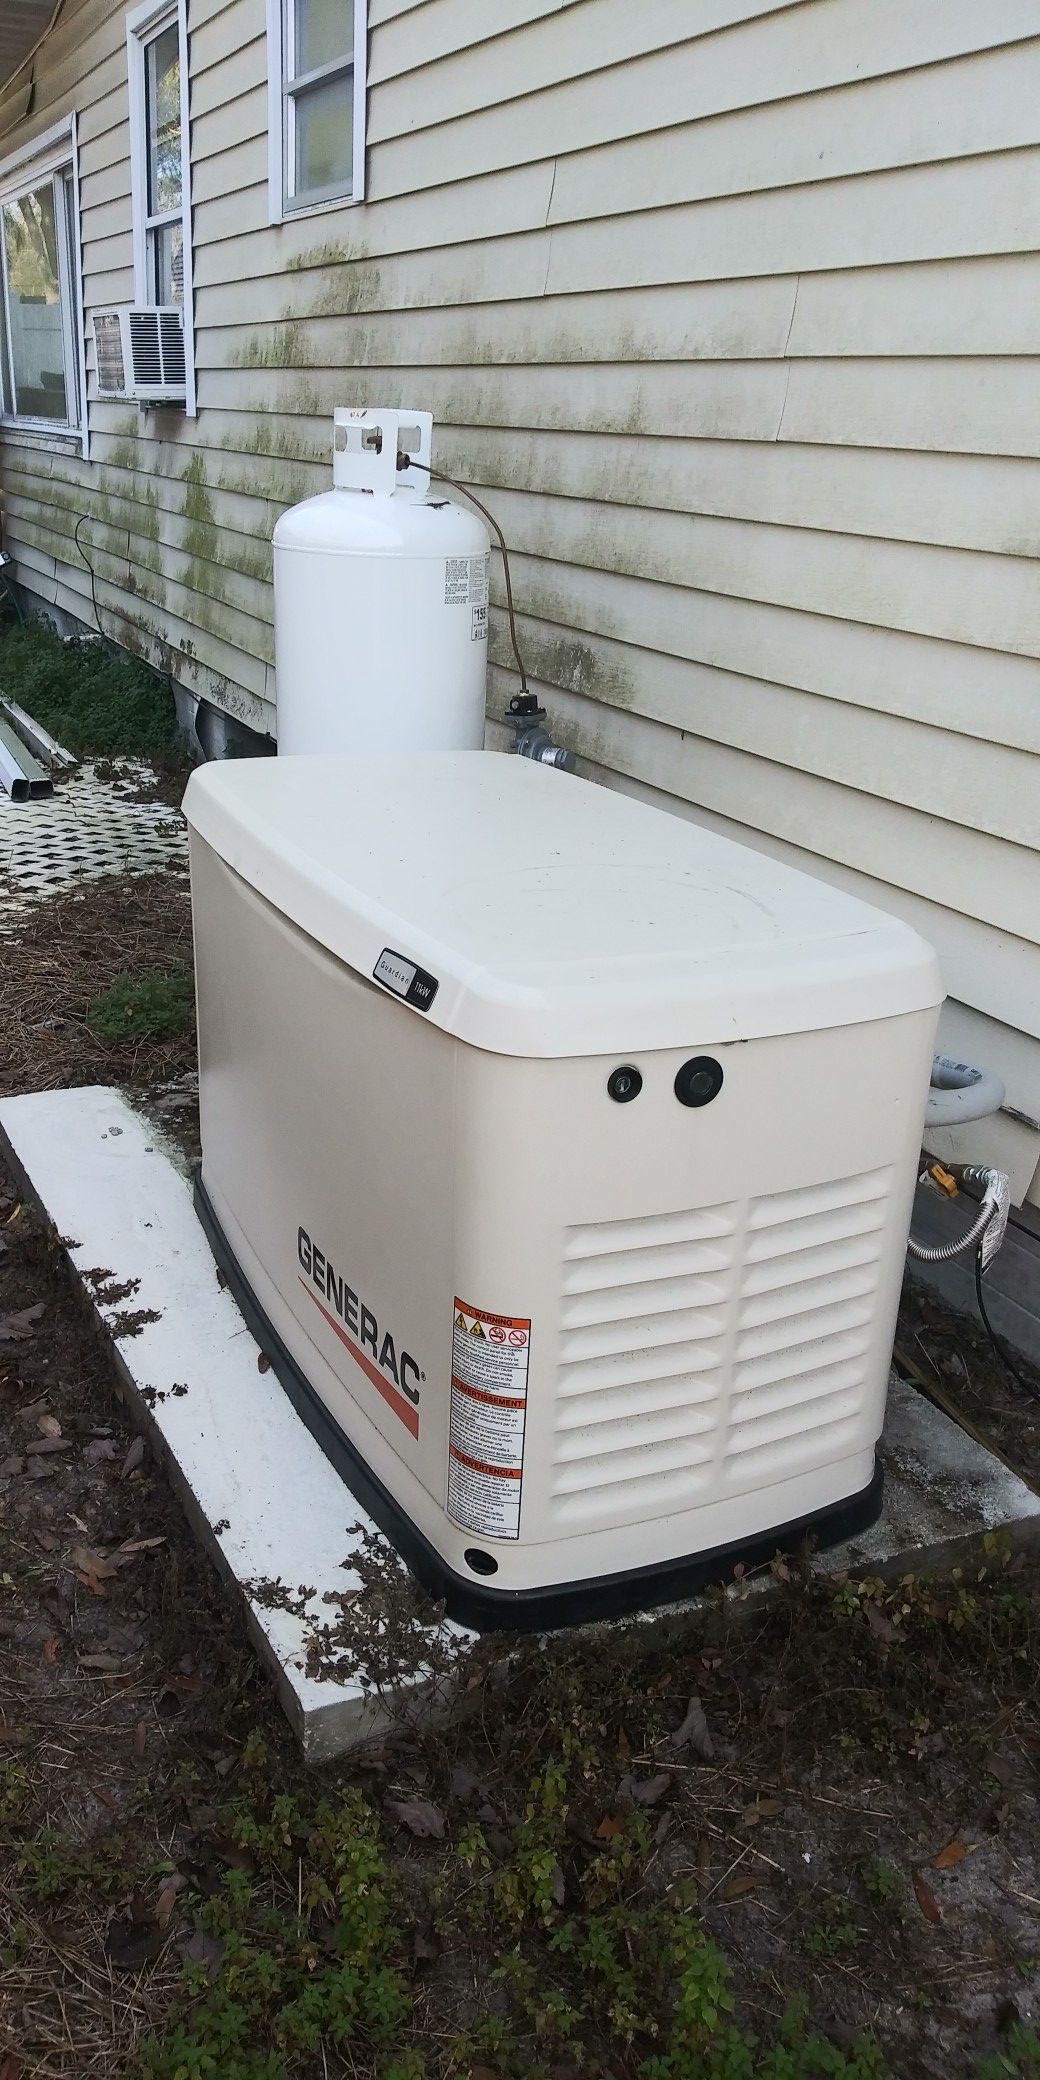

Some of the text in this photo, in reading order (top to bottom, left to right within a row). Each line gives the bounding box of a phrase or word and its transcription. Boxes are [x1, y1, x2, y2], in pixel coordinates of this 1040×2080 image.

[380, 960, 410, 985] Guardian
[297, 1226, 420, 1405] GENERAC
[474, 1310, 513, 1327] WARNING
[460, 1384, 523, 1407] AVERTISSEMENT
[460, 1455, 515, 1477] ADVERTENCIA
